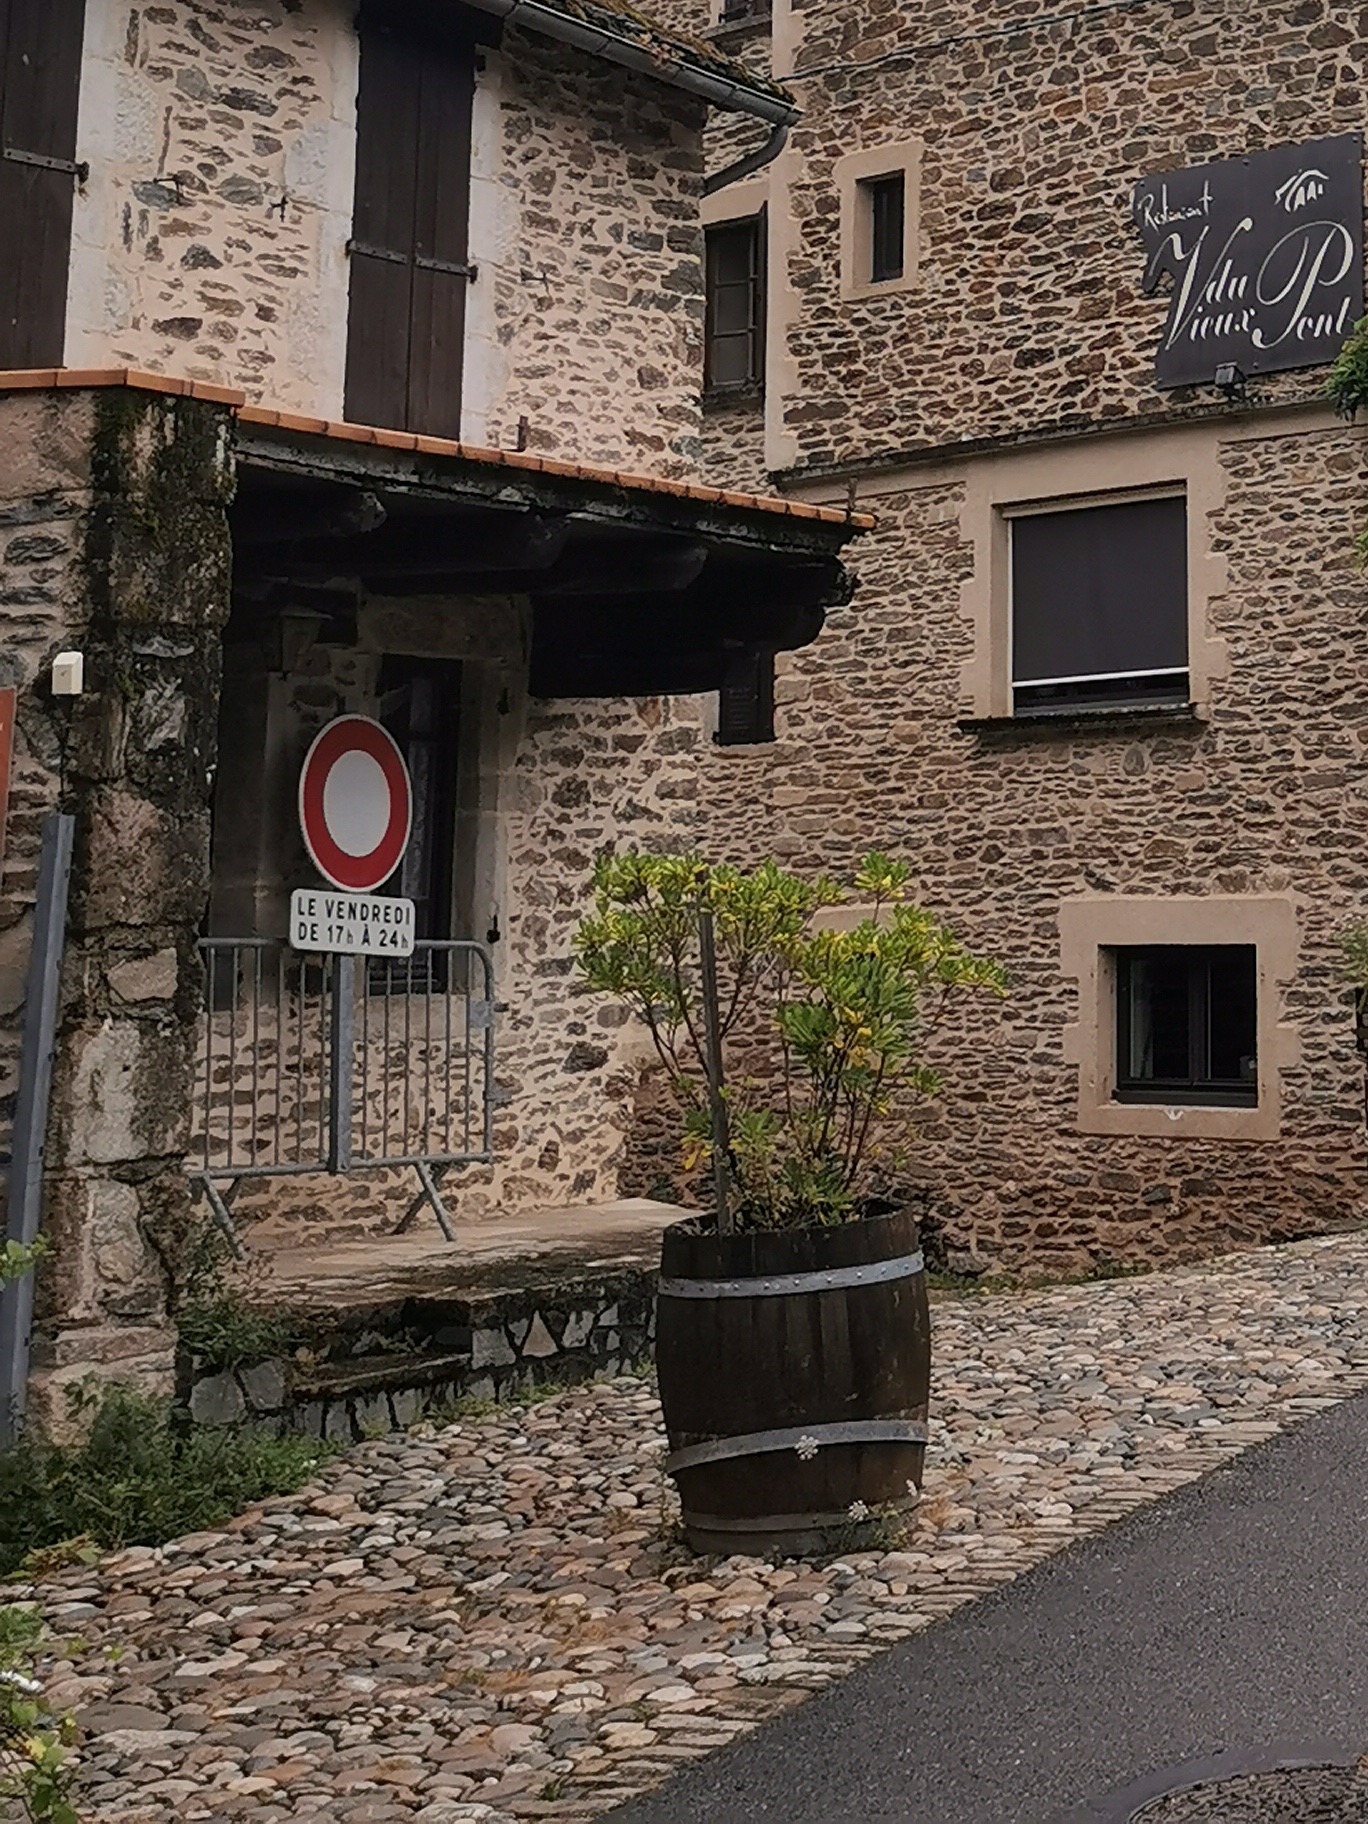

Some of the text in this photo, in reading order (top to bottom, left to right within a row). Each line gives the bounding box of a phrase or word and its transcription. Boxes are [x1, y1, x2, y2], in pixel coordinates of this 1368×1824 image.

[1149, 217, 1354, 350] Vieux Pont
[1206, 259, 1248, 304] du
[298, 896, 411, 926] LE VENDREDI
[298, 921, 319, 943] DE
[361, 923, 371, 947] À
